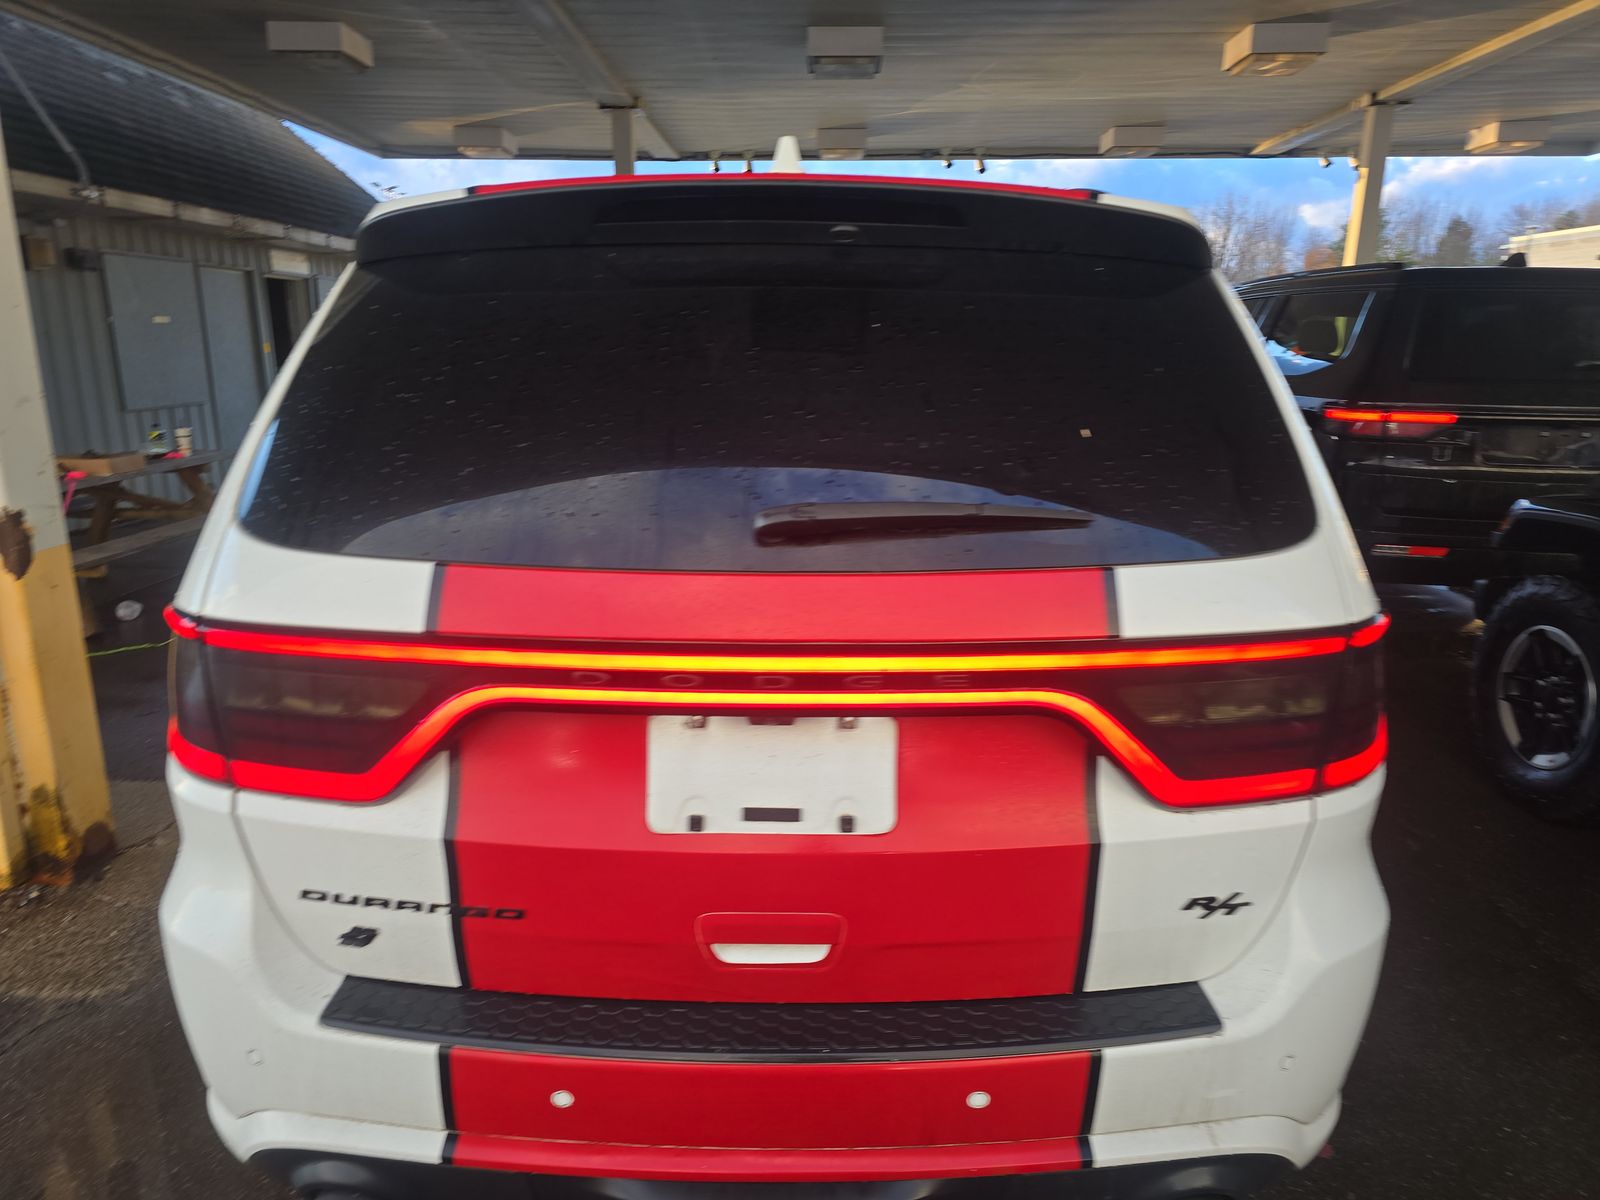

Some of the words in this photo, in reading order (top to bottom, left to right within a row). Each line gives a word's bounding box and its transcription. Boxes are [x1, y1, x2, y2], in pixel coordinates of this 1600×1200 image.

[571, 670, 971, 689] DODGE
[300, 889, 526, 919] DURANGO
[1181, 892, 1251, 919] R/T
